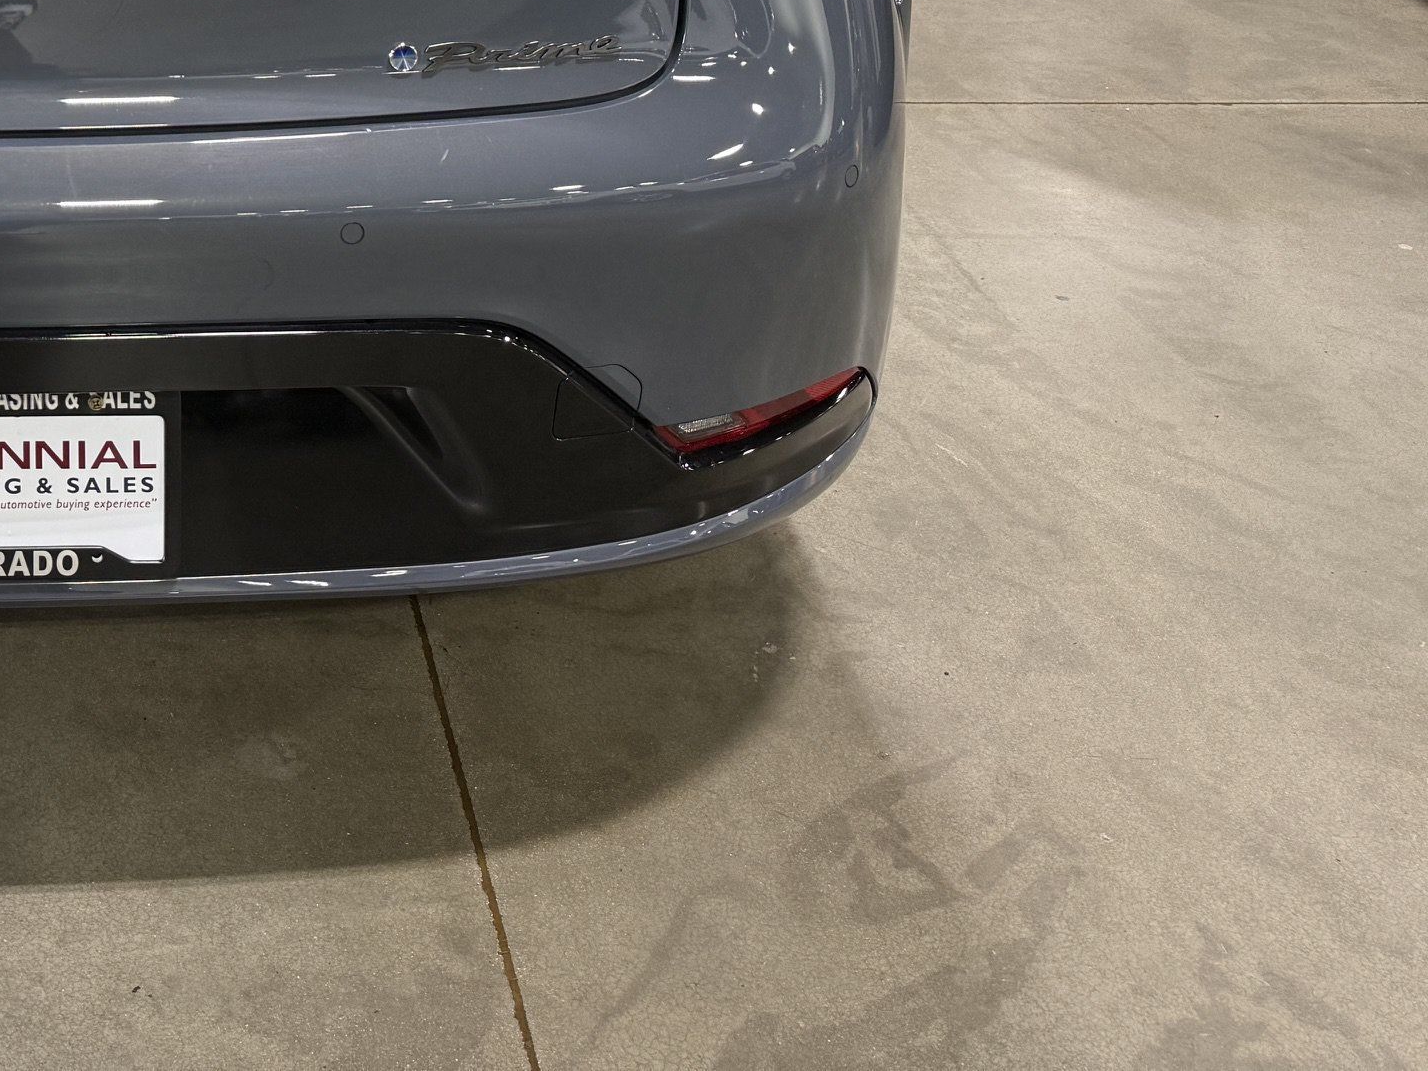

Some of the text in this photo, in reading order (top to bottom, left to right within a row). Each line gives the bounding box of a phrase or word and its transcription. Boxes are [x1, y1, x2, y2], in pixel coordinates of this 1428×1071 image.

[422, 35, 621, 72] Prime
[65, 393, 79, 410] &
[88, 390, 156, 411] ALES
[36, 478, 53, 495] &
[66, 476, 155, 494] SALES
[56, 498, 91, 512] buying
